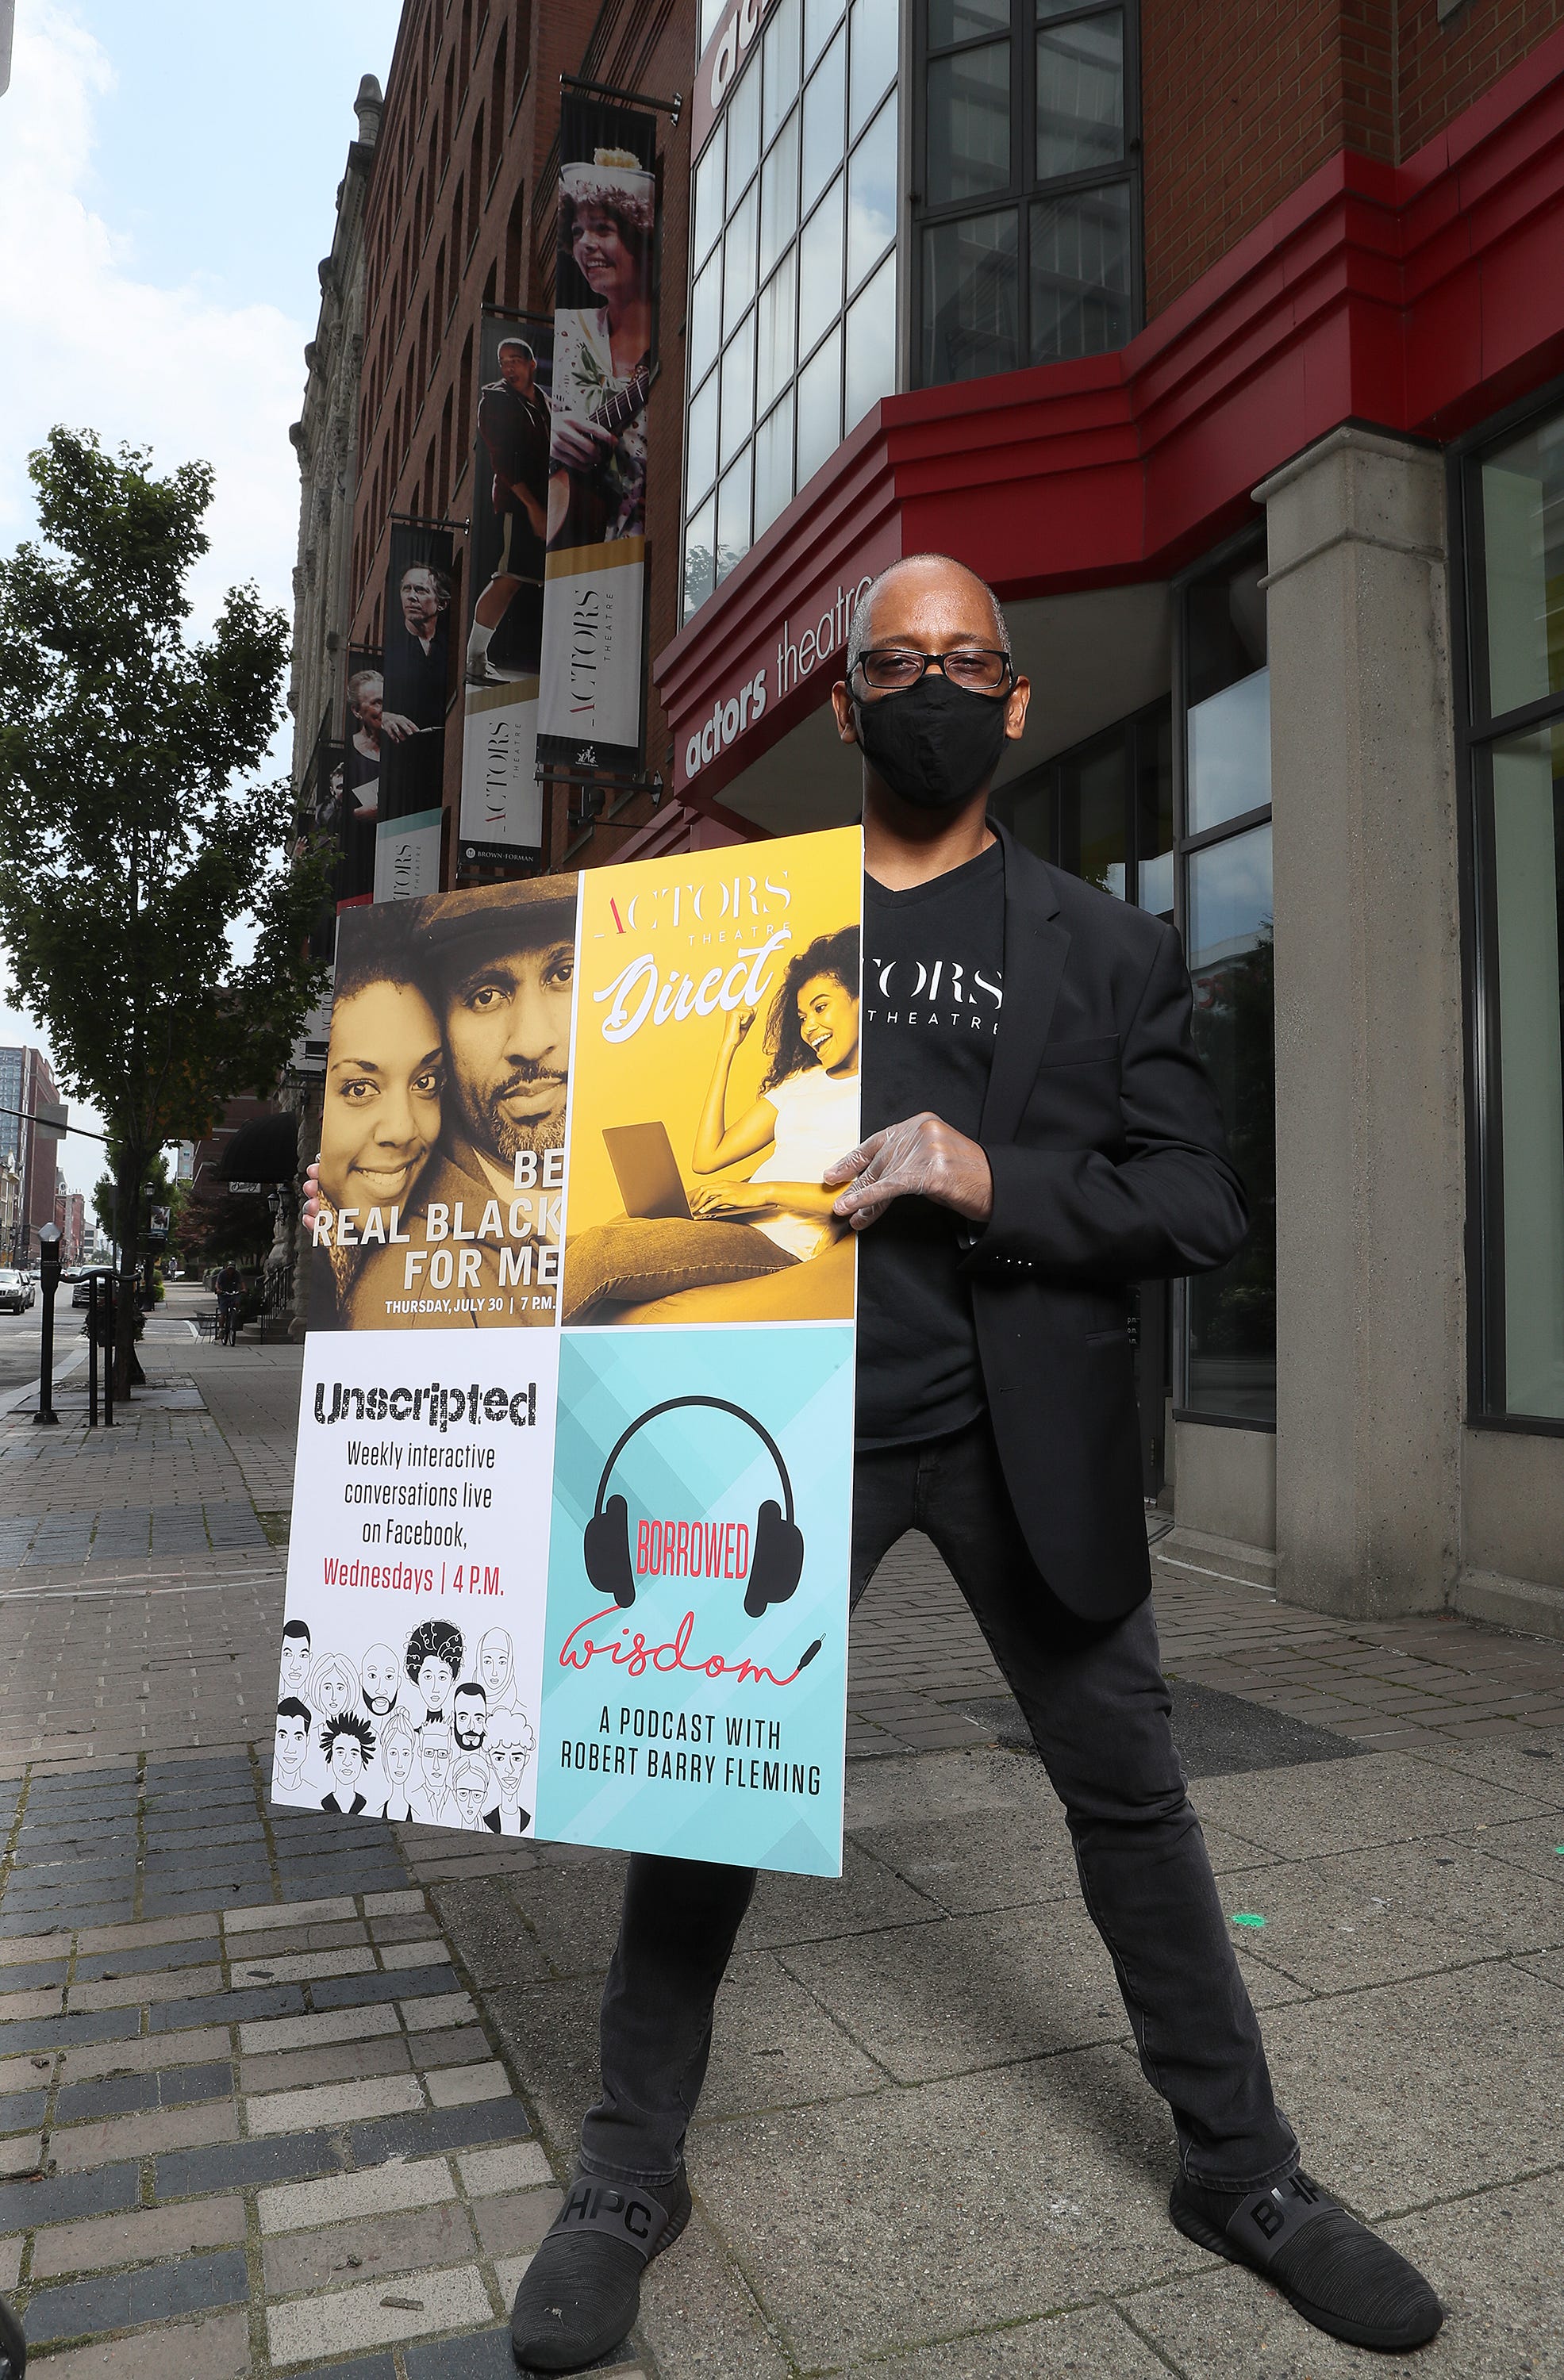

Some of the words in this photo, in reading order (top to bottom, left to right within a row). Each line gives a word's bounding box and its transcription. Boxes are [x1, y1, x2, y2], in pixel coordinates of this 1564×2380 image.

[604, 593, 614, 662] THEATRE
[570, 590, 599, 727] ACTORS
[686, 669, 767, 779] actors
[485, 722, 509, 832] ACTORS
[594, 869, 792, 938] ACTORS
[688, 921, 792, 946] THEATRE
[593, 931, 792, 1044] Direct
[513, 1147, 564, 1190] BE
[312, 1205, 411, 1248] REAL
[425, 1196, 563, 1242] BLACK
[403, 1247, 482, 1290] FOR
[498, 1244, 559, 1287] ME
[385, 1299, 452, 1315] THURSDAY,
[453, 1297, 486, 1313] JULY
[487, 1296, 504, 1311] 30
[521, 1296, 528, 1310] 7
[532, 1295, 557, 1311] P.M.
[314, 1382, 537, 1433] Unscripted
[348, 1441, 403, 1470] Weekly
[407, 1442, 496, 1469] interactive
[344, 1481, 458, 1507] conversations
[463, 1481, 493, 1509] live
[362, 1522, 381, 1543] on
[386, 1518, 467, 1550] Facebook,
[636, 1519, 750, 1580] BORROWED
[324, 1557, 434, 1595] Wednesdays
[452, 1564, 463, 1594] 4
[469, 1564, 505, 1596] P.M.
[599, 1705, 610, 1733] A
[620, 1707, 716, 1745] PODCAST
[725, 1715, 781, 1751] WITH
[560, 1740, 638, 1776] ROBERT
[648, 1749, 716, 1784] BARRY
[725, 1757, 820, 1796] FLEMING
[563, 2187, 651, 2240] HPC
